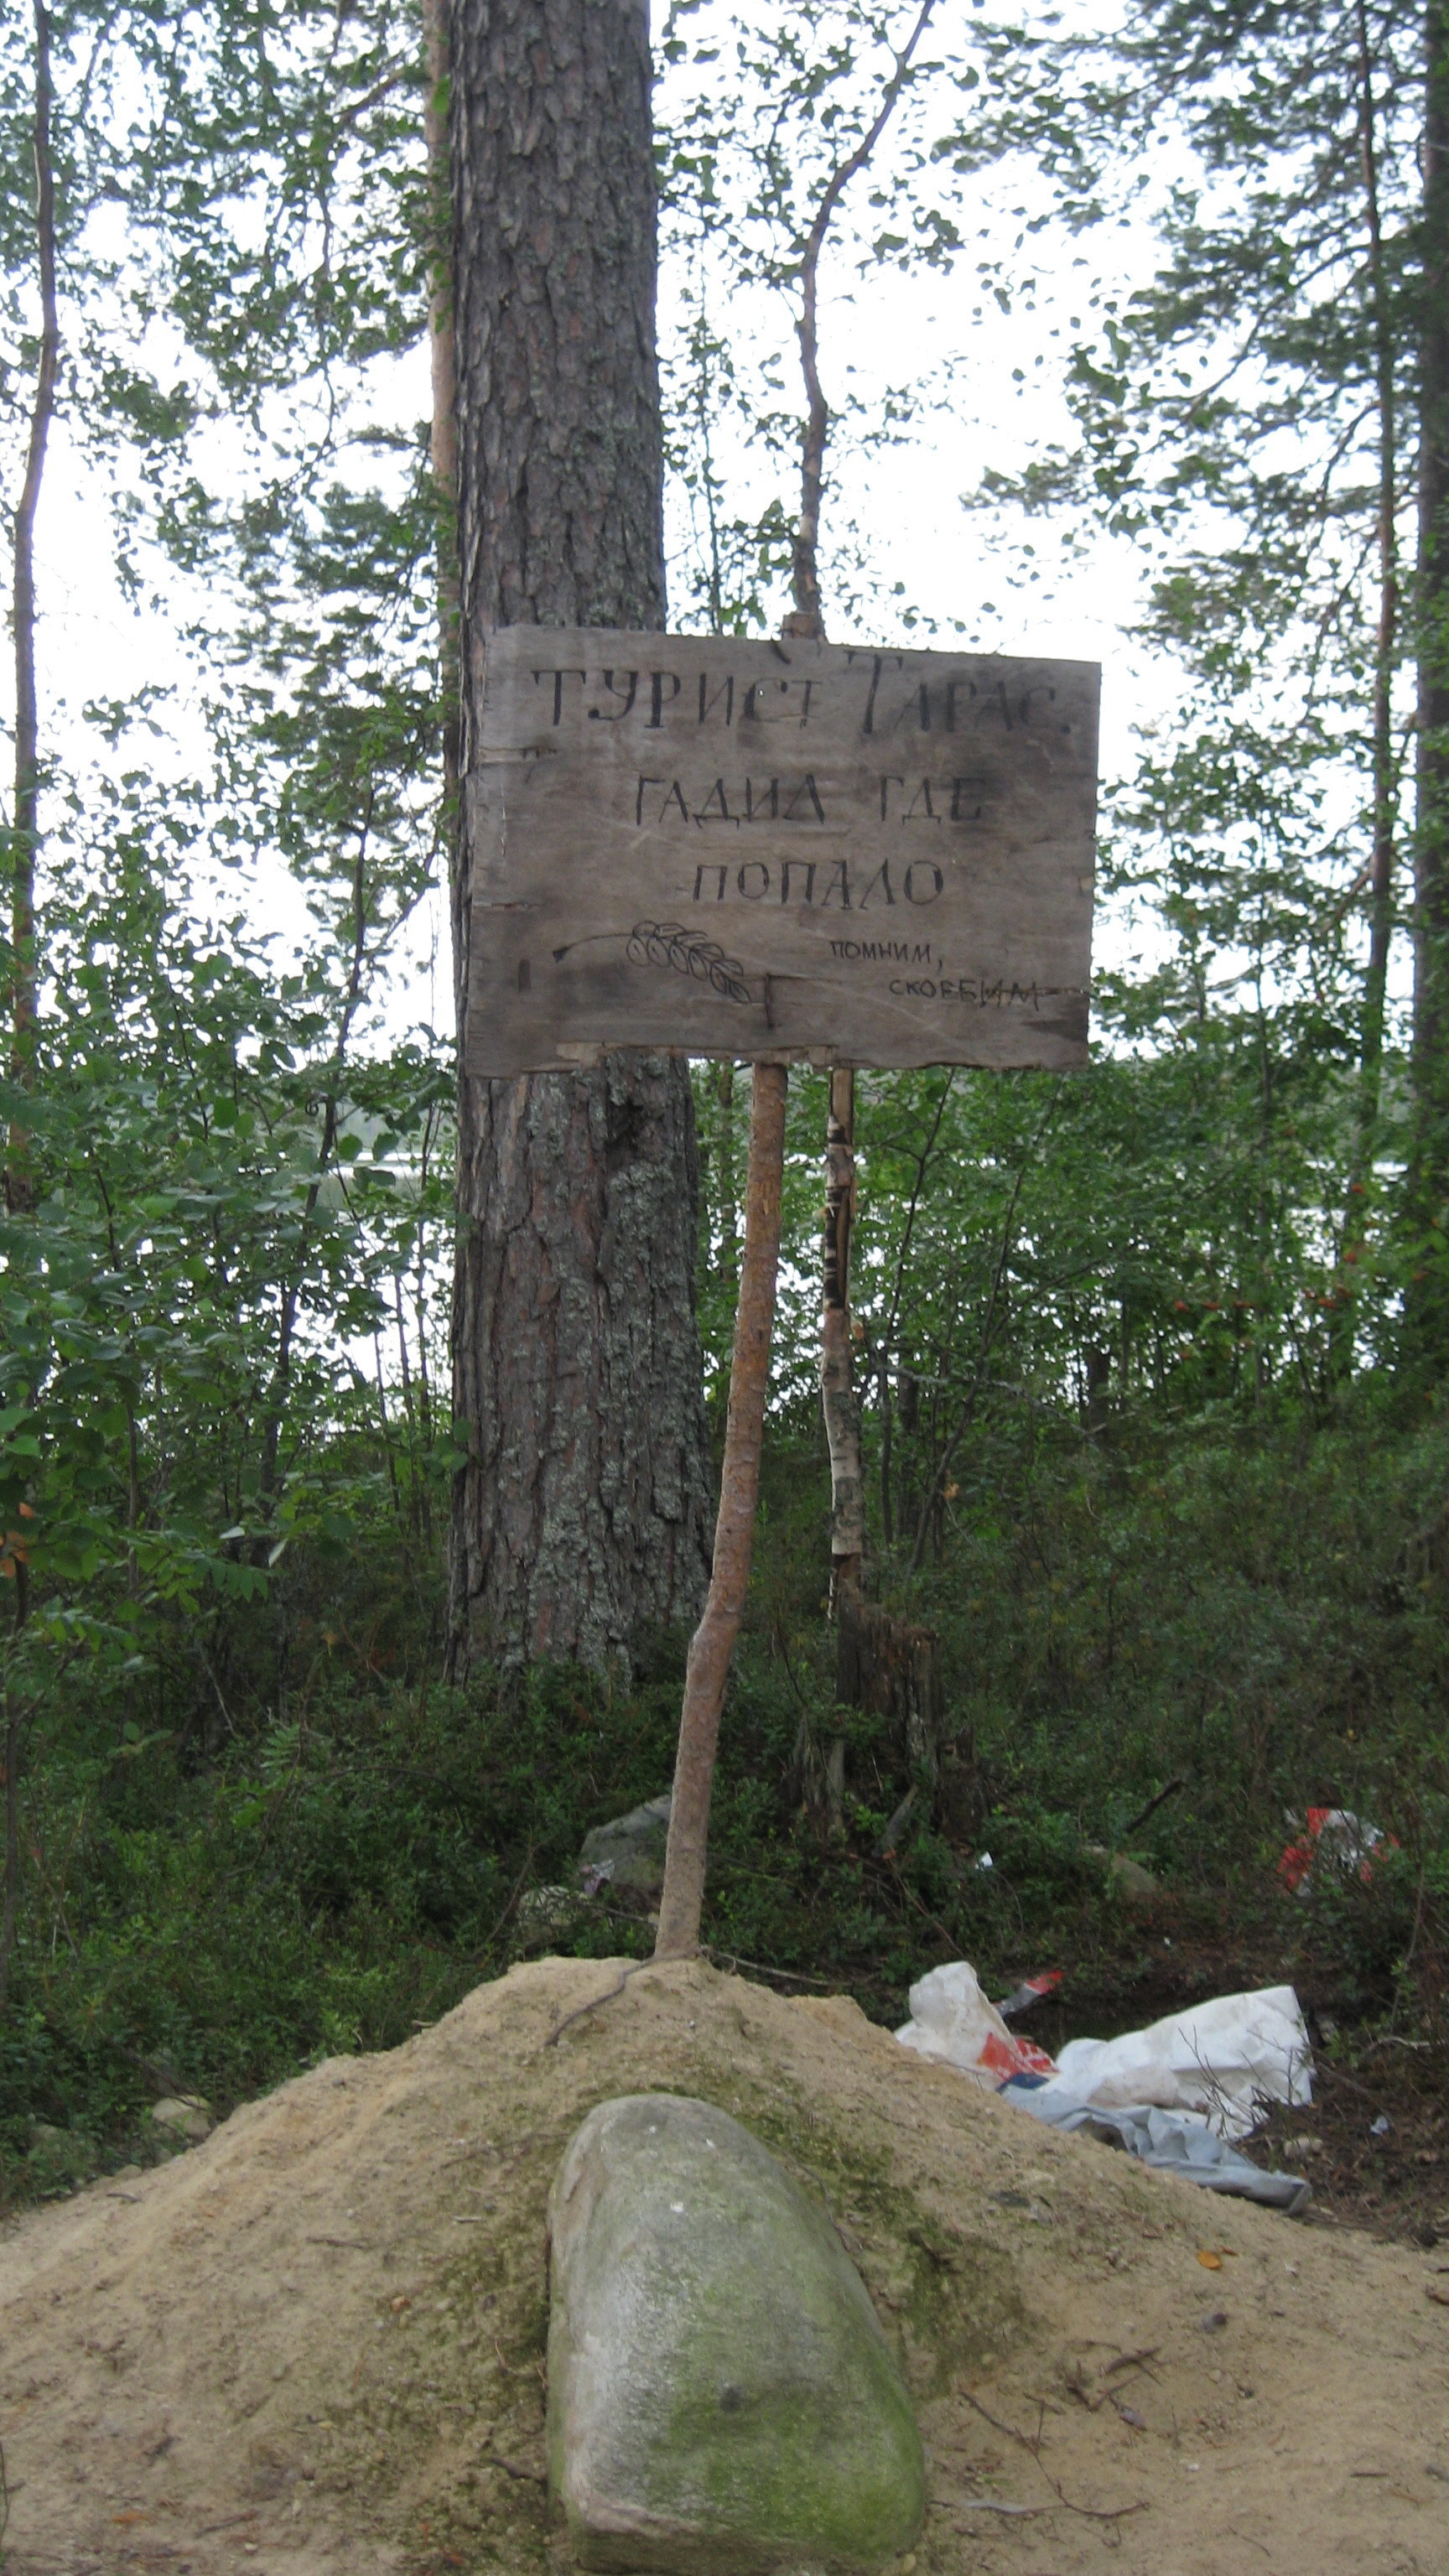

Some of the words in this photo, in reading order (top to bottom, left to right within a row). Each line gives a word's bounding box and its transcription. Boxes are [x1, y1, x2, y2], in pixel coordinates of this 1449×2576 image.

[532, 668, 822, 730] ТУРИСТ
[636, 773, 826, 828] ГАДИЛ
[878, 776, 989, 825] ГДЕ
[691, 858, 945, 910] ПОПАЛО
